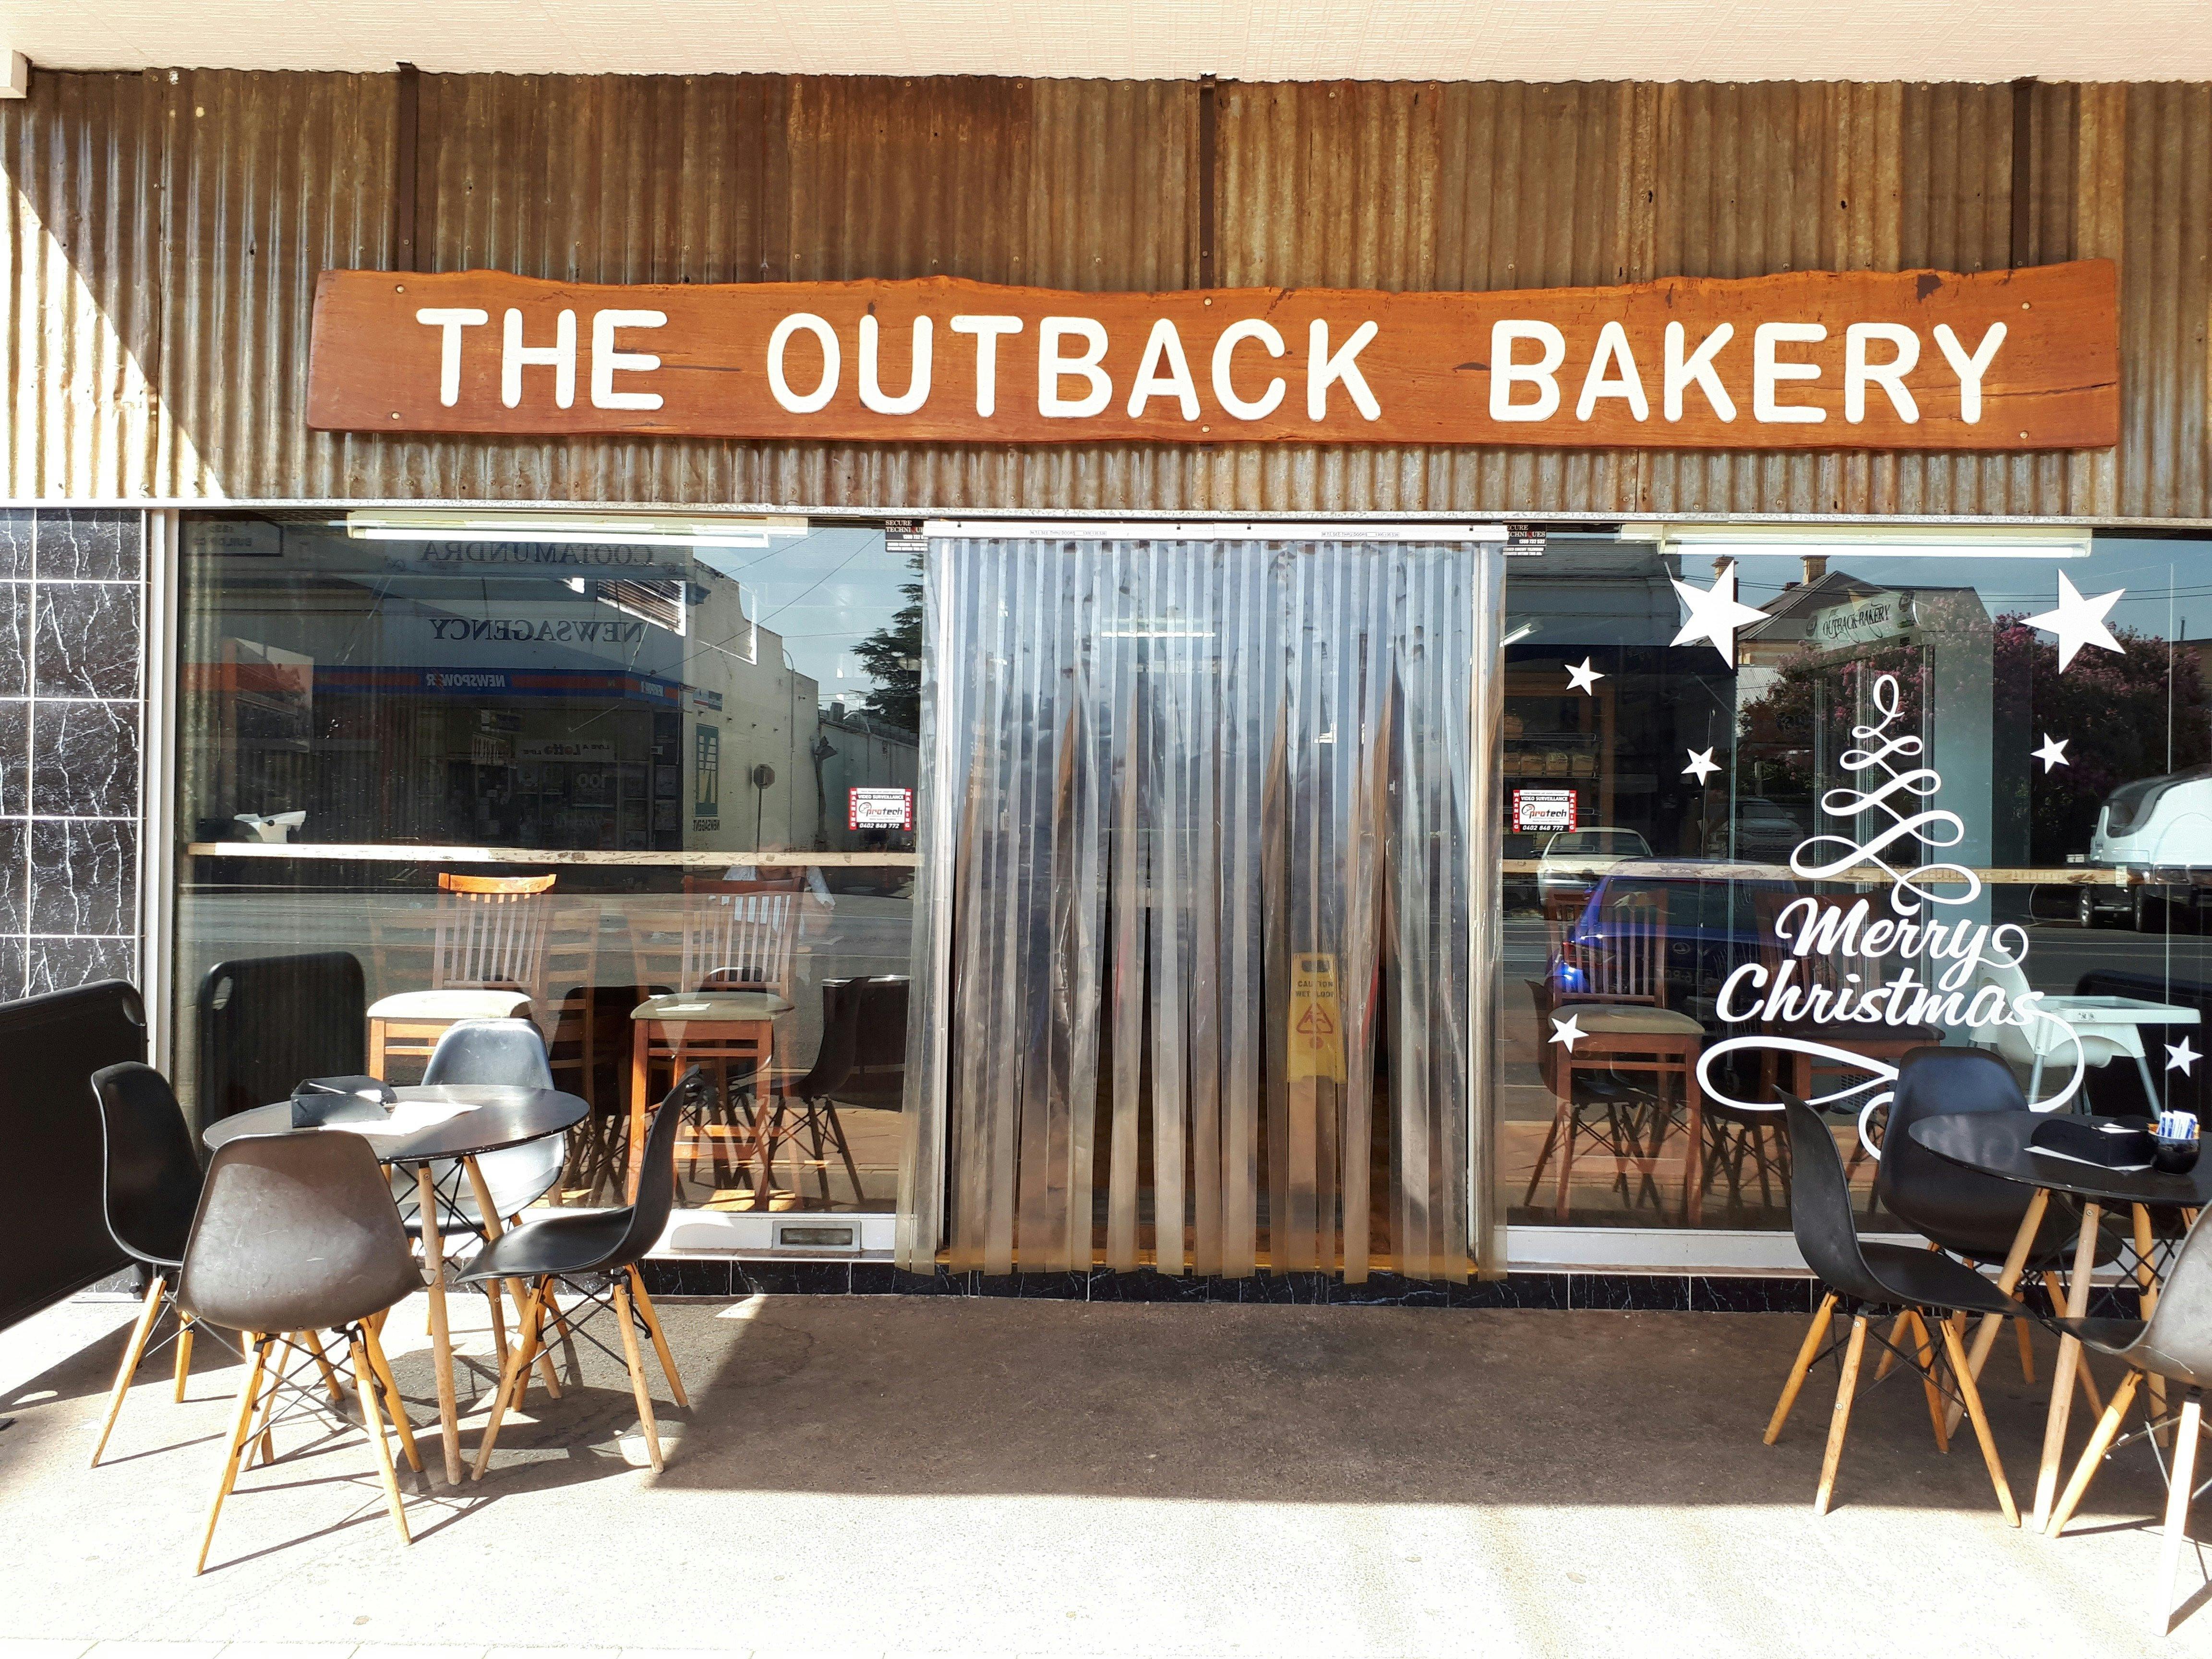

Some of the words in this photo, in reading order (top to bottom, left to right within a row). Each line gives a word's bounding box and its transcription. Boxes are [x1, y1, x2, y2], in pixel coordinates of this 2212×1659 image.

[416, 308, 668, 411] THE
[767, 313, 1382, 422] OUTBACK
[1489, 319, 2008, 424] BAKERY
[866, 807, 903, 817] protech
[1528, 809, 1567, 819] protech
[1776, 897, 2029, 991] Merry
[1716, 959, 2045, 1028] Christmas
